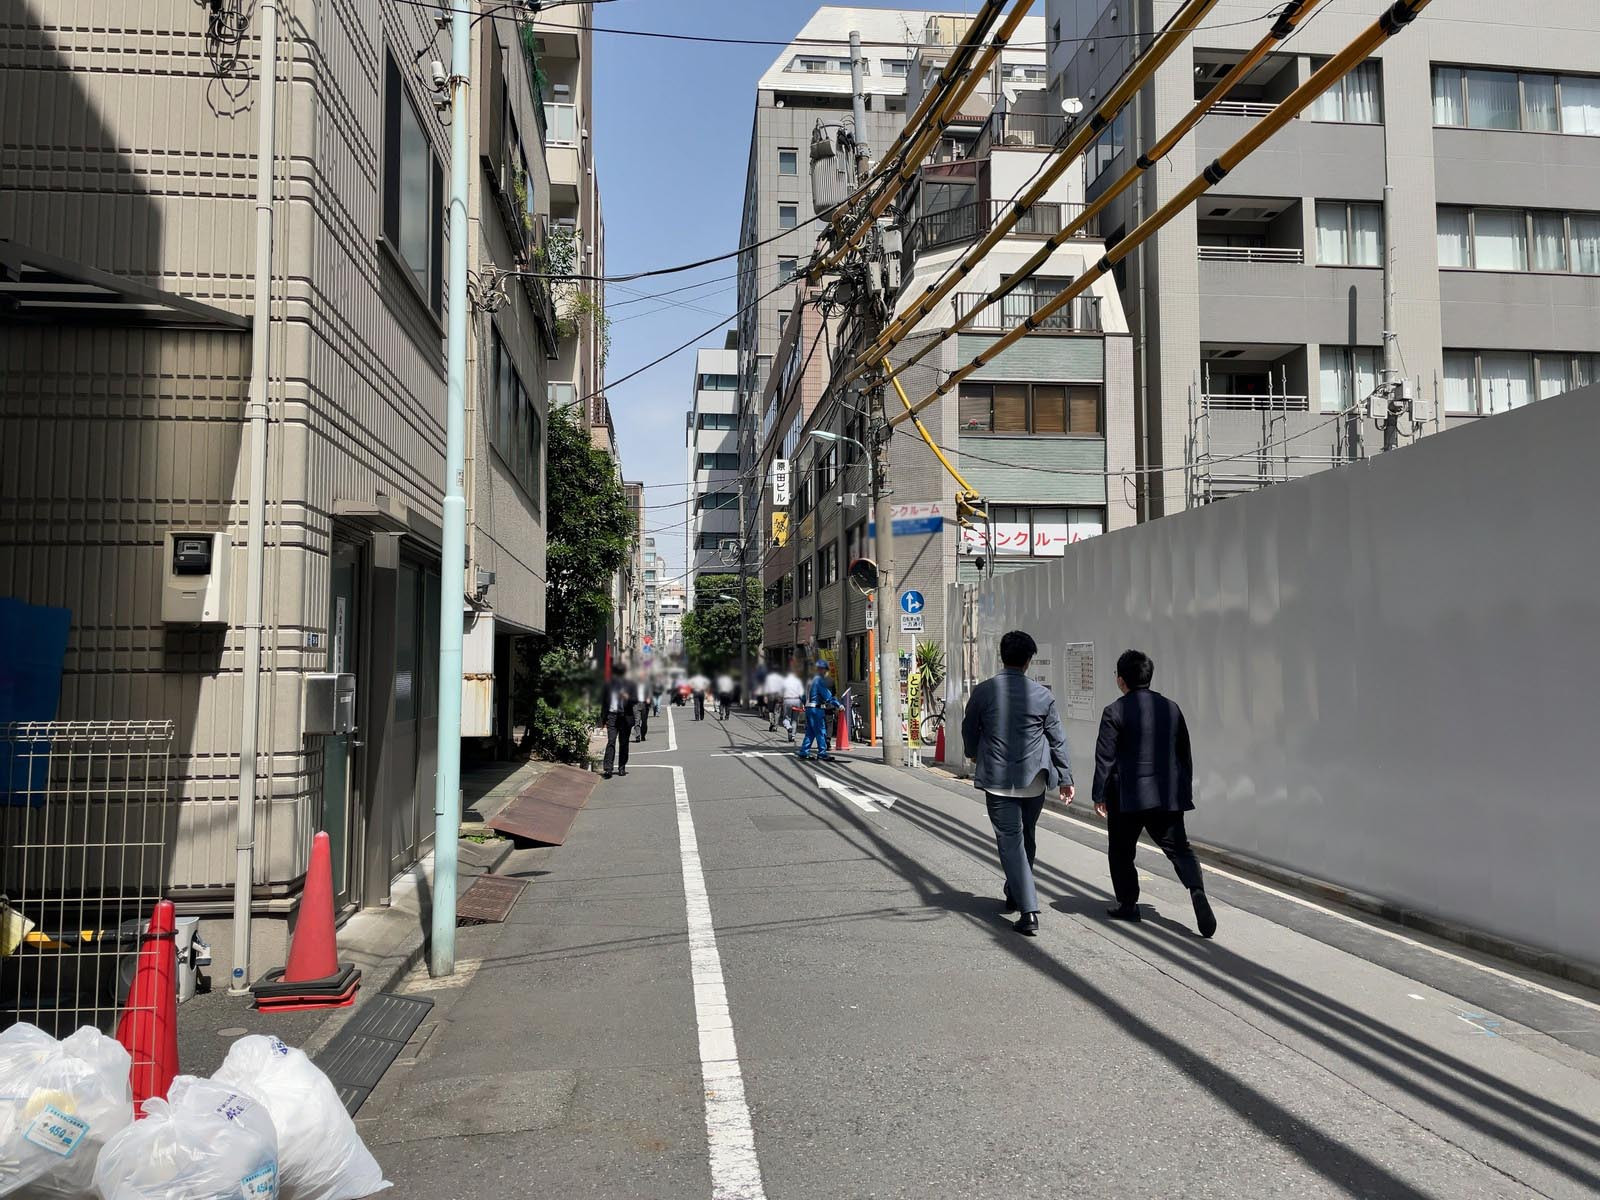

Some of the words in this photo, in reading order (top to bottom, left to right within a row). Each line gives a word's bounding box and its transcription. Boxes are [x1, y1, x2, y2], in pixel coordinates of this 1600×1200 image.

[776, 461, 786, 502] 原田ビル
[871, 503, 940, 517] ンクルーム
[910, 676, 919, 740] とびだし注意
